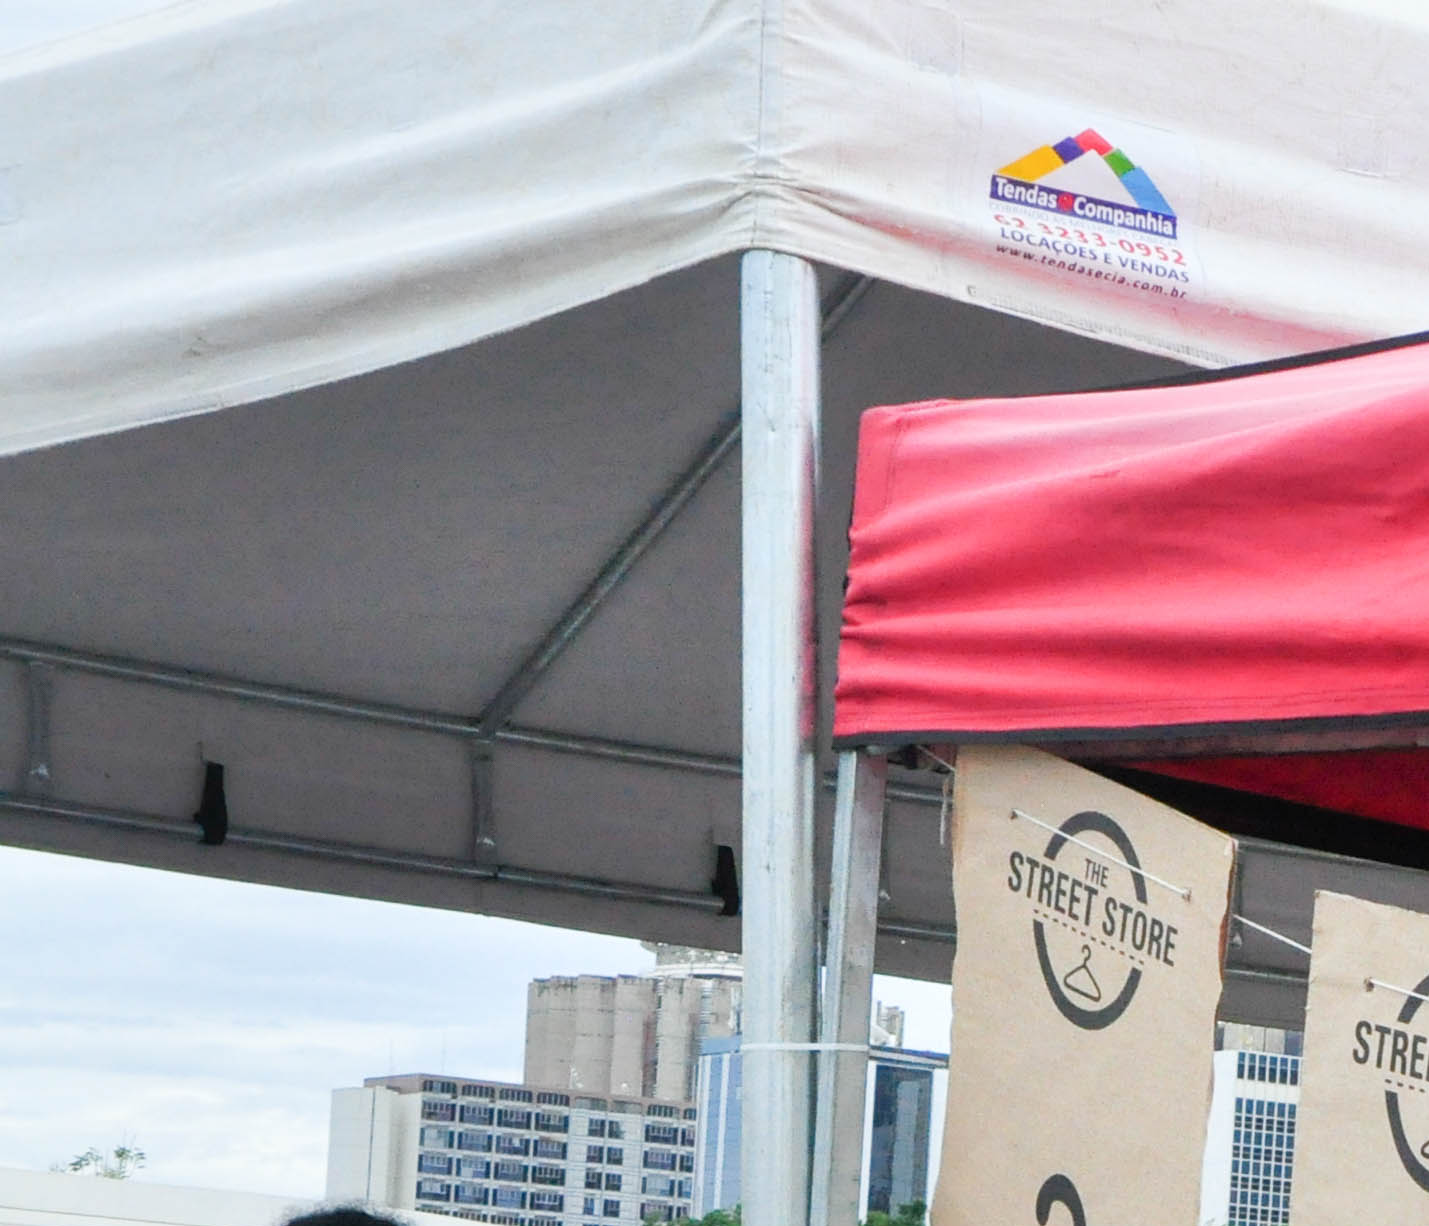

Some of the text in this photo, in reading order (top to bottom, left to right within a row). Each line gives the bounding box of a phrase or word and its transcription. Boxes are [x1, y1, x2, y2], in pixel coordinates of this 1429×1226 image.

[996, 179, 1057, 208] Tendas
[1073, 197, 1173, 236] Companhia
[995, 245, 1187, 299] www.tendasecia.com.br
[1104, 253, 1113, 265] E
[1117, 256, 1190, 283] VENDAS
[1085, 858, 1109, 888] THE
[1008, 851, 1178, 967] STREET STORE
